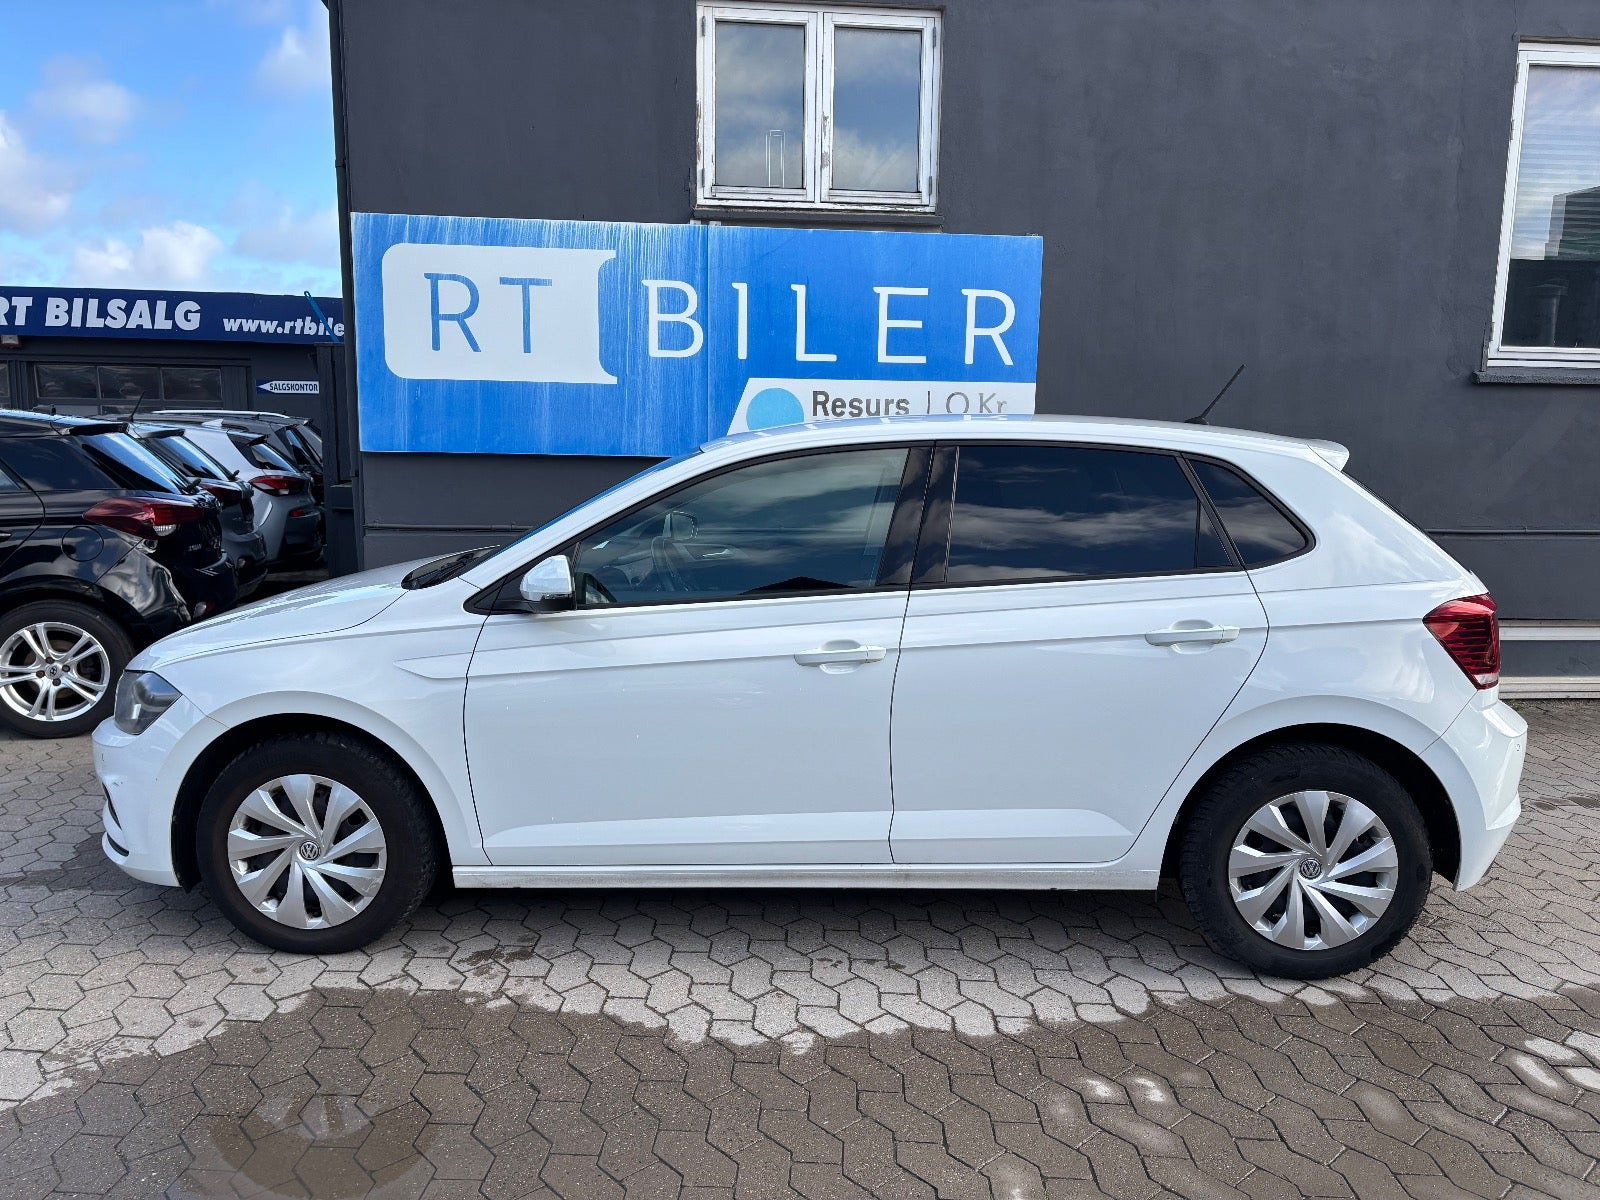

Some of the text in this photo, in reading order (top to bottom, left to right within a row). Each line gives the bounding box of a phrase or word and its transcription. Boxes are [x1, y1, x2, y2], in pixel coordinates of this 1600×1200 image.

[45, 297, 201, 331] BILSALG
[423, 273, 1015, 366] RT BILER
[269, 382, 318, 391] SALGSKONTOR
[812, 390, 910, 417] Resurs
